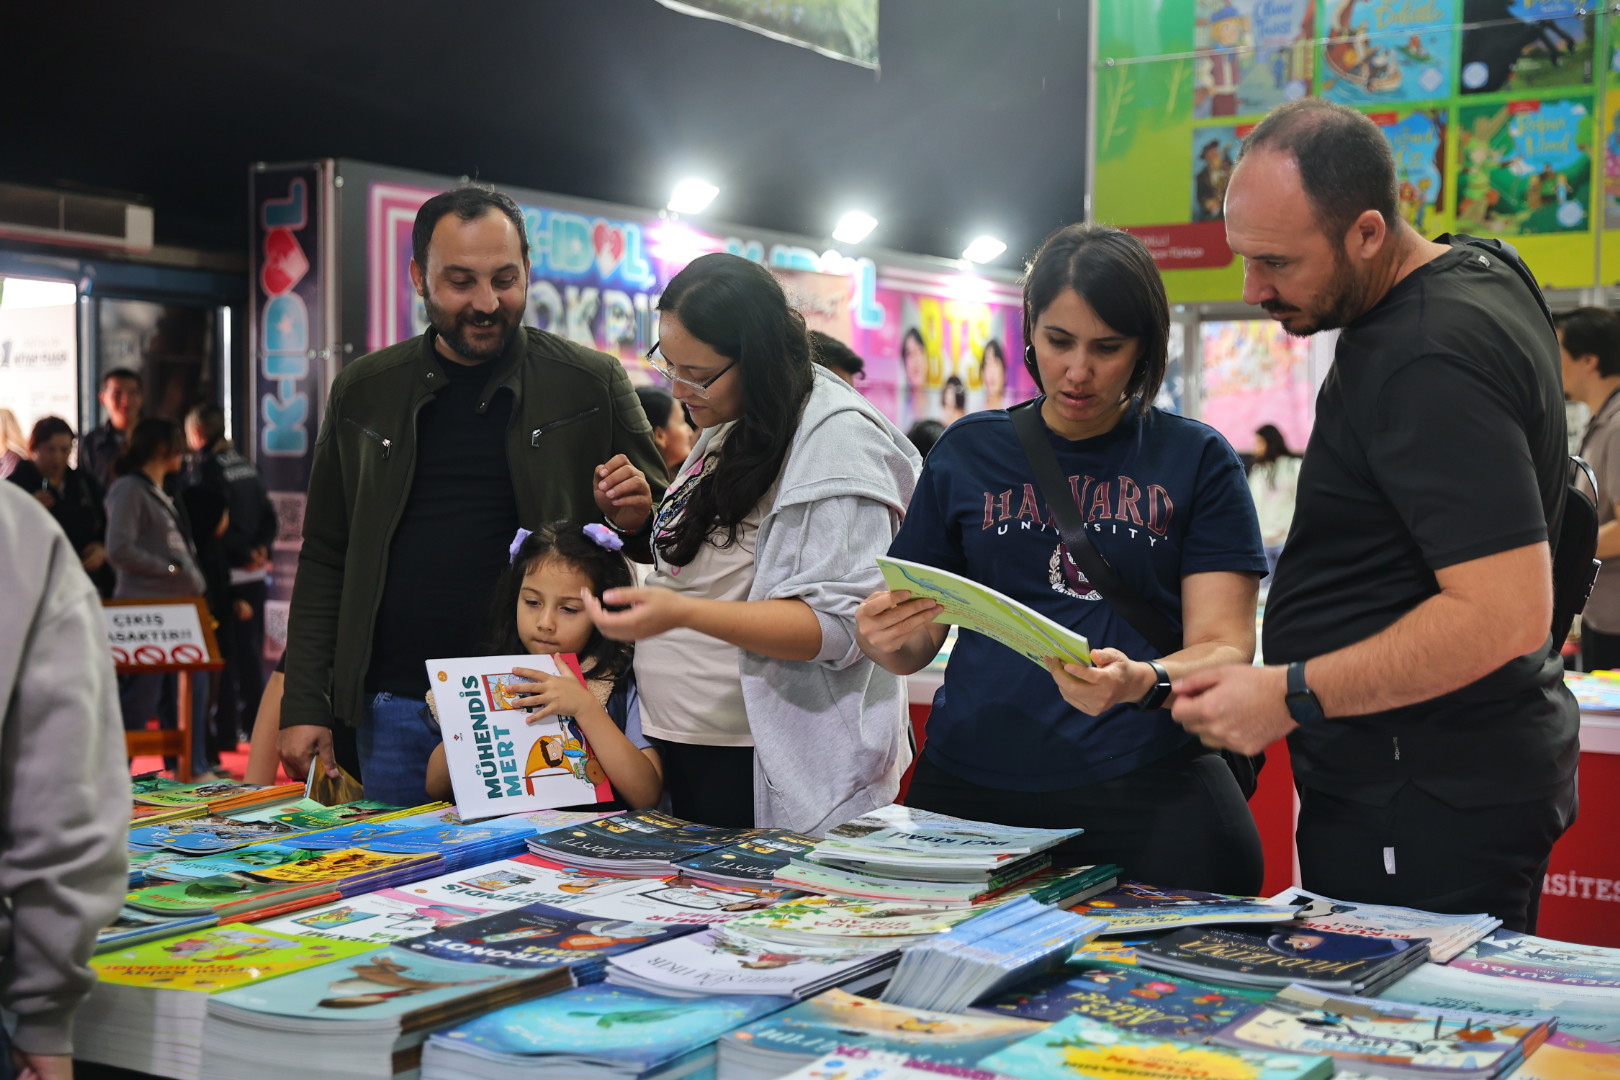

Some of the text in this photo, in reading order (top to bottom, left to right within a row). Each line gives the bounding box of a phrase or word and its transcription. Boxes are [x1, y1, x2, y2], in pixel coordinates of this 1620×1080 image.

[919, 297, 993, 390] BTS
[983, 475, 1174, 536] HAVARD
[997, 520, 1158, 547] UNISITY
[459, 675, 503, 799] MÜHENDİS
[493, 725, 523, 797] MERT
[426, 939, 588, 963] ASTRONOT
[521, 945, 604, 957] SEMA
[1471, 962, 1556, 980] KUTBU
